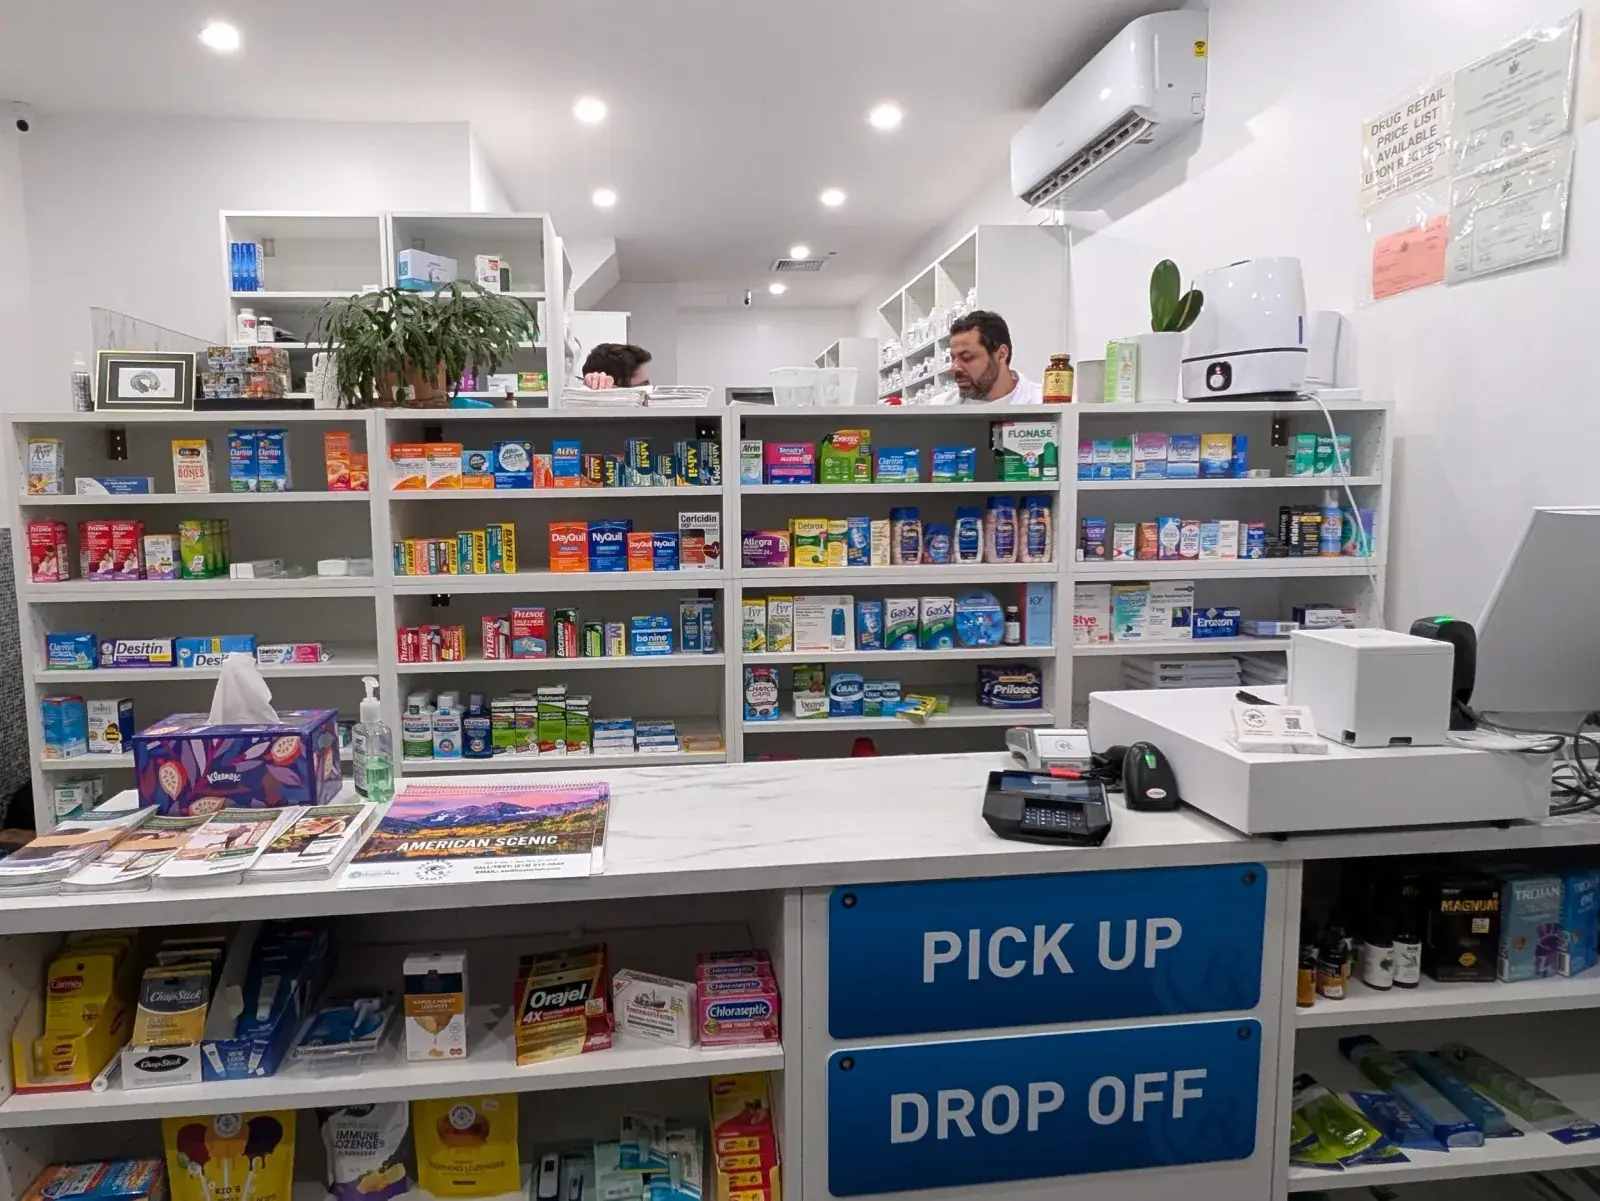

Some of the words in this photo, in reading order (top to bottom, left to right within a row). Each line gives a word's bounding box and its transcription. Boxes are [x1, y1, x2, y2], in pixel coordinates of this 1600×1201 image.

[1371, 111, 1401, 136] DRUG
[1406, 88, 1446, 116] RETAIL
[1377, 123, 1408, 148] PRICE
[1414, 107, 1438, 129] LIST
[1377, 124, 1438, 164] AVAILABLE
[1008, 429, 1053, 439] FLONASE
[742, 444, 761, 453] Afrin
[640, 442, 650, 468] Advil
[878, 457, 904, 465] Claritin
[592, 458, 601, 479] Advil
[687, 447, 698, 478] Advil
[178, 469, 205, 479] BONES
[605, 461, 615, 485] Advil
[680, 514, 717, 523] Coricidin
[797, 522, 825, 531] Debrox
[551, 533, 587, 542] DayQuil
[592, 532, 623, 542] NyQuil
[743, 538, 772, 547] Allegra
[476, 534, 484, 565] BAYER
[505, 528, 513, 562] BAYER
[653, 540, 676, 548] NyQuil
[513, 610, 544, 618] TYLENOL
[745, 607, 765, 619] Ayr
[771, 602, 792, 615] Ayr
[1073, 615, 1097, 626] Stye
[1197, 617, 1233, 627] Eroxon
[485, 621, 495, 658] TYLENOL
[557, 622, 565, 657] EXCEDRIN
[636, 633, 668, 642] bonine
[49, 643, 75, 651] Claritin
[116, 642, 163, 655] Desitin
[195, 654, 229, 666] Desi
[835, 684, 859, 692] COLACE
[993, 684, 1039, 695] Prilosec
[801, 700, 825, 709] beano
[207, 771, 241, 784] Kleenex
[397, 838, 491, 852] AMERICAN
[493, 835, 558, 847] SCENIC
[1515, 885, 1560, 901] TROJAN
[1440, 899, 1499, 912] MAGNUM
[923, 923, 1075, 983] PICK
[1098, 917, 1182, 971] UP
[50, 978, 82, 990] Carmex
[710, 981, 758, 990] Chloraseptic
[150, 990, 201, 1002] ChapStick
[530, 983, 588, 1009] Orajel
[523, 1010, 542, 1023] 4X
[709, 1004, 767, 1018] Chloraseptic
[140, 1057, 181, 1069] ChapStick
[890, 1082, 1065, 1145] DROP
[1088, 1069, 1207, 1126] OFF
[336, 1131, 380, 1141] IMMUNE
[335, 1139, 386, 1150] OZENGES
[215, 1185, 241, 1195] KID'S
